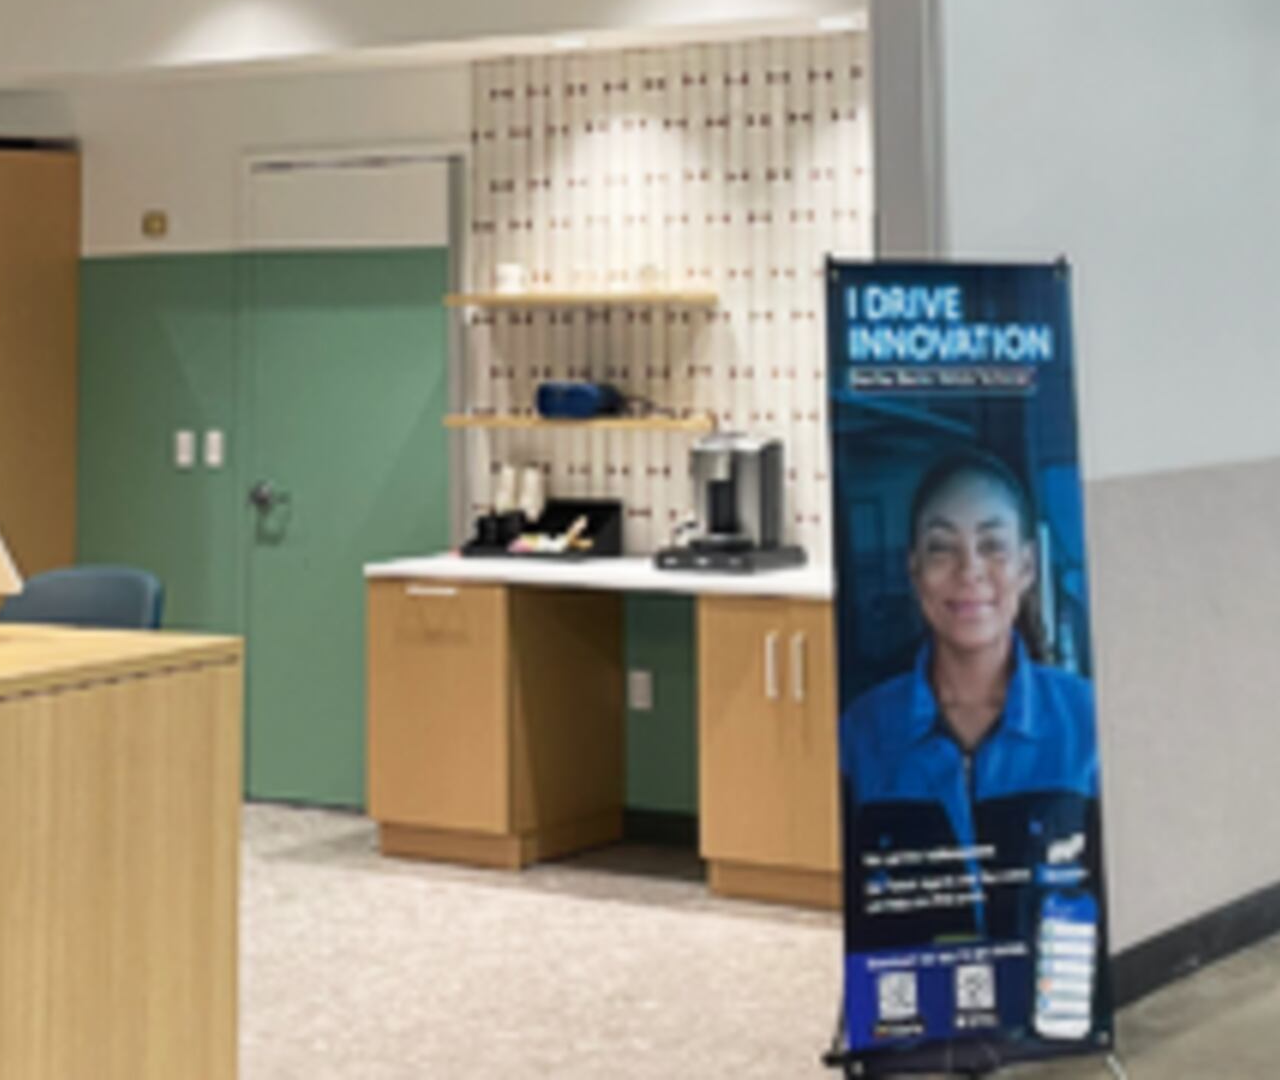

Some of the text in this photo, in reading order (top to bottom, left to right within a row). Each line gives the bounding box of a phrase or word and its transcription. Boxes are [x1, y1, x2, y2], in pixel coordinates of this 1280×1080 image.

[847, 286, 962, 320] I DRIVE
[848, 324, 1053, 361] INNOVATION
